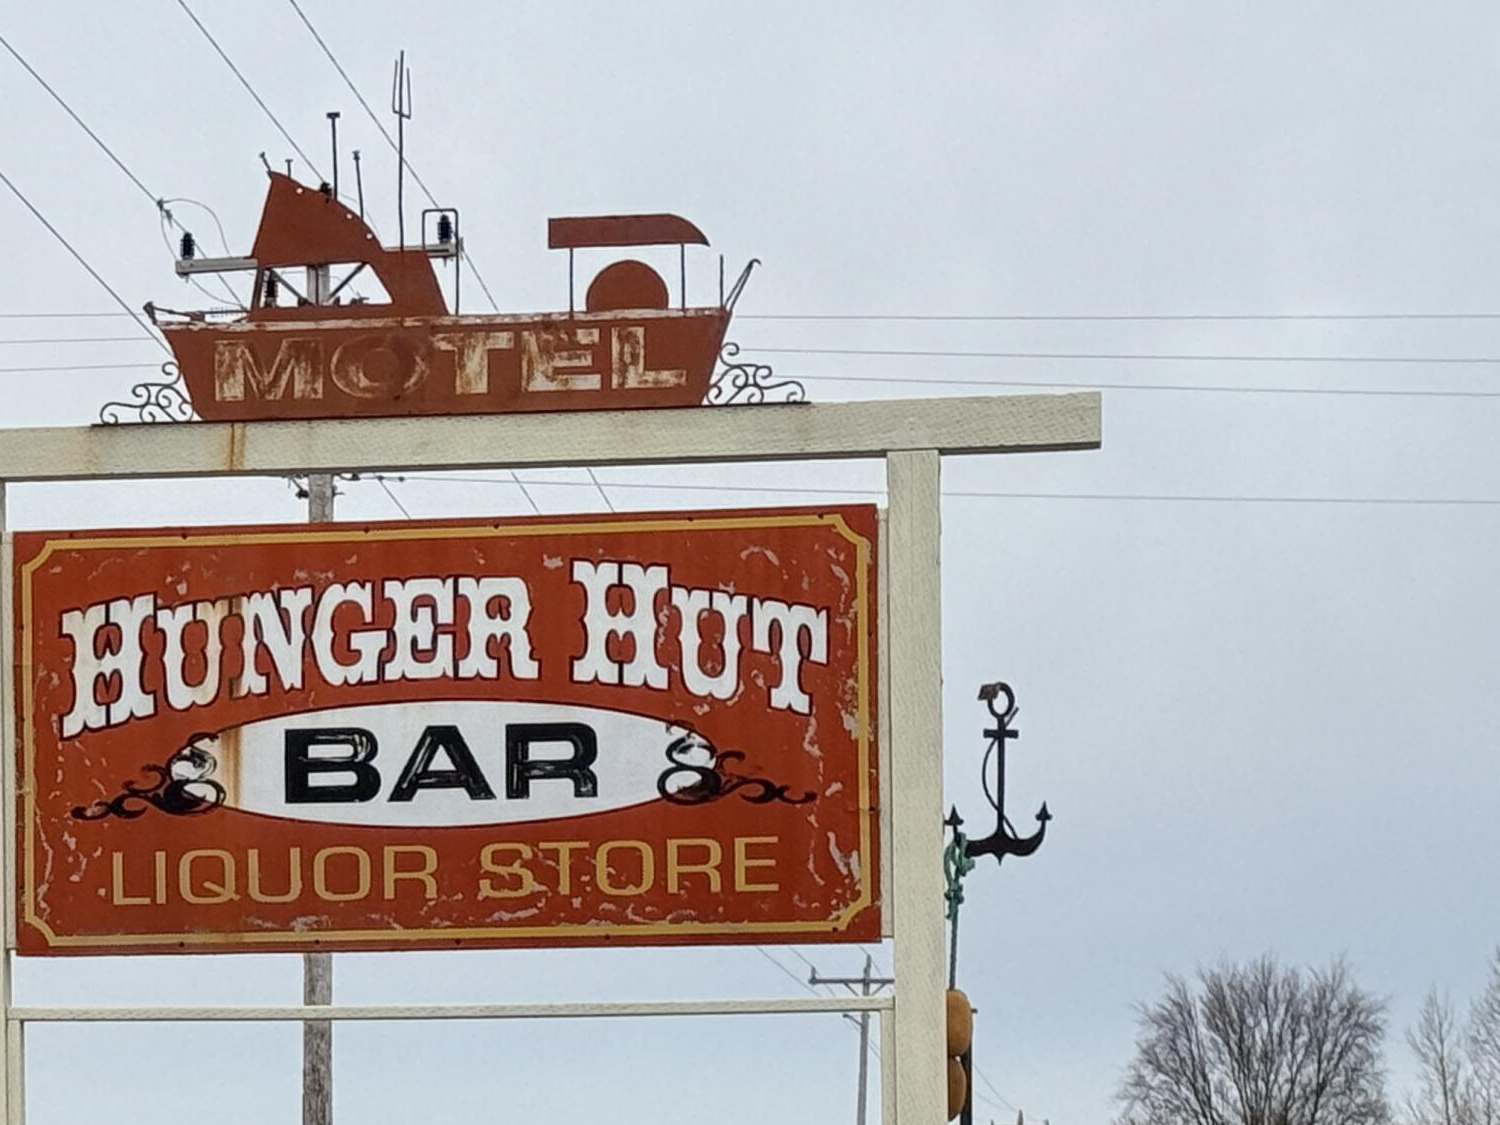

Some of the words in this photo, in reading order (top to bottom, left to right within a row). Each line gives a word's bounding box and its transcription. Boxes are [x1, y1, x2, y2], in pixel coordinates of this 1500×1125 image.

[214, 326, 687, 402] MOTEL
[60, 574, 540, 741] HUNGER
[571, 559, 831, 715] HUT
[284, 721, 600, 804] BAR
[109, 843, 439, 907] LIQUOR
[479, 835, 781, 900] STORE
